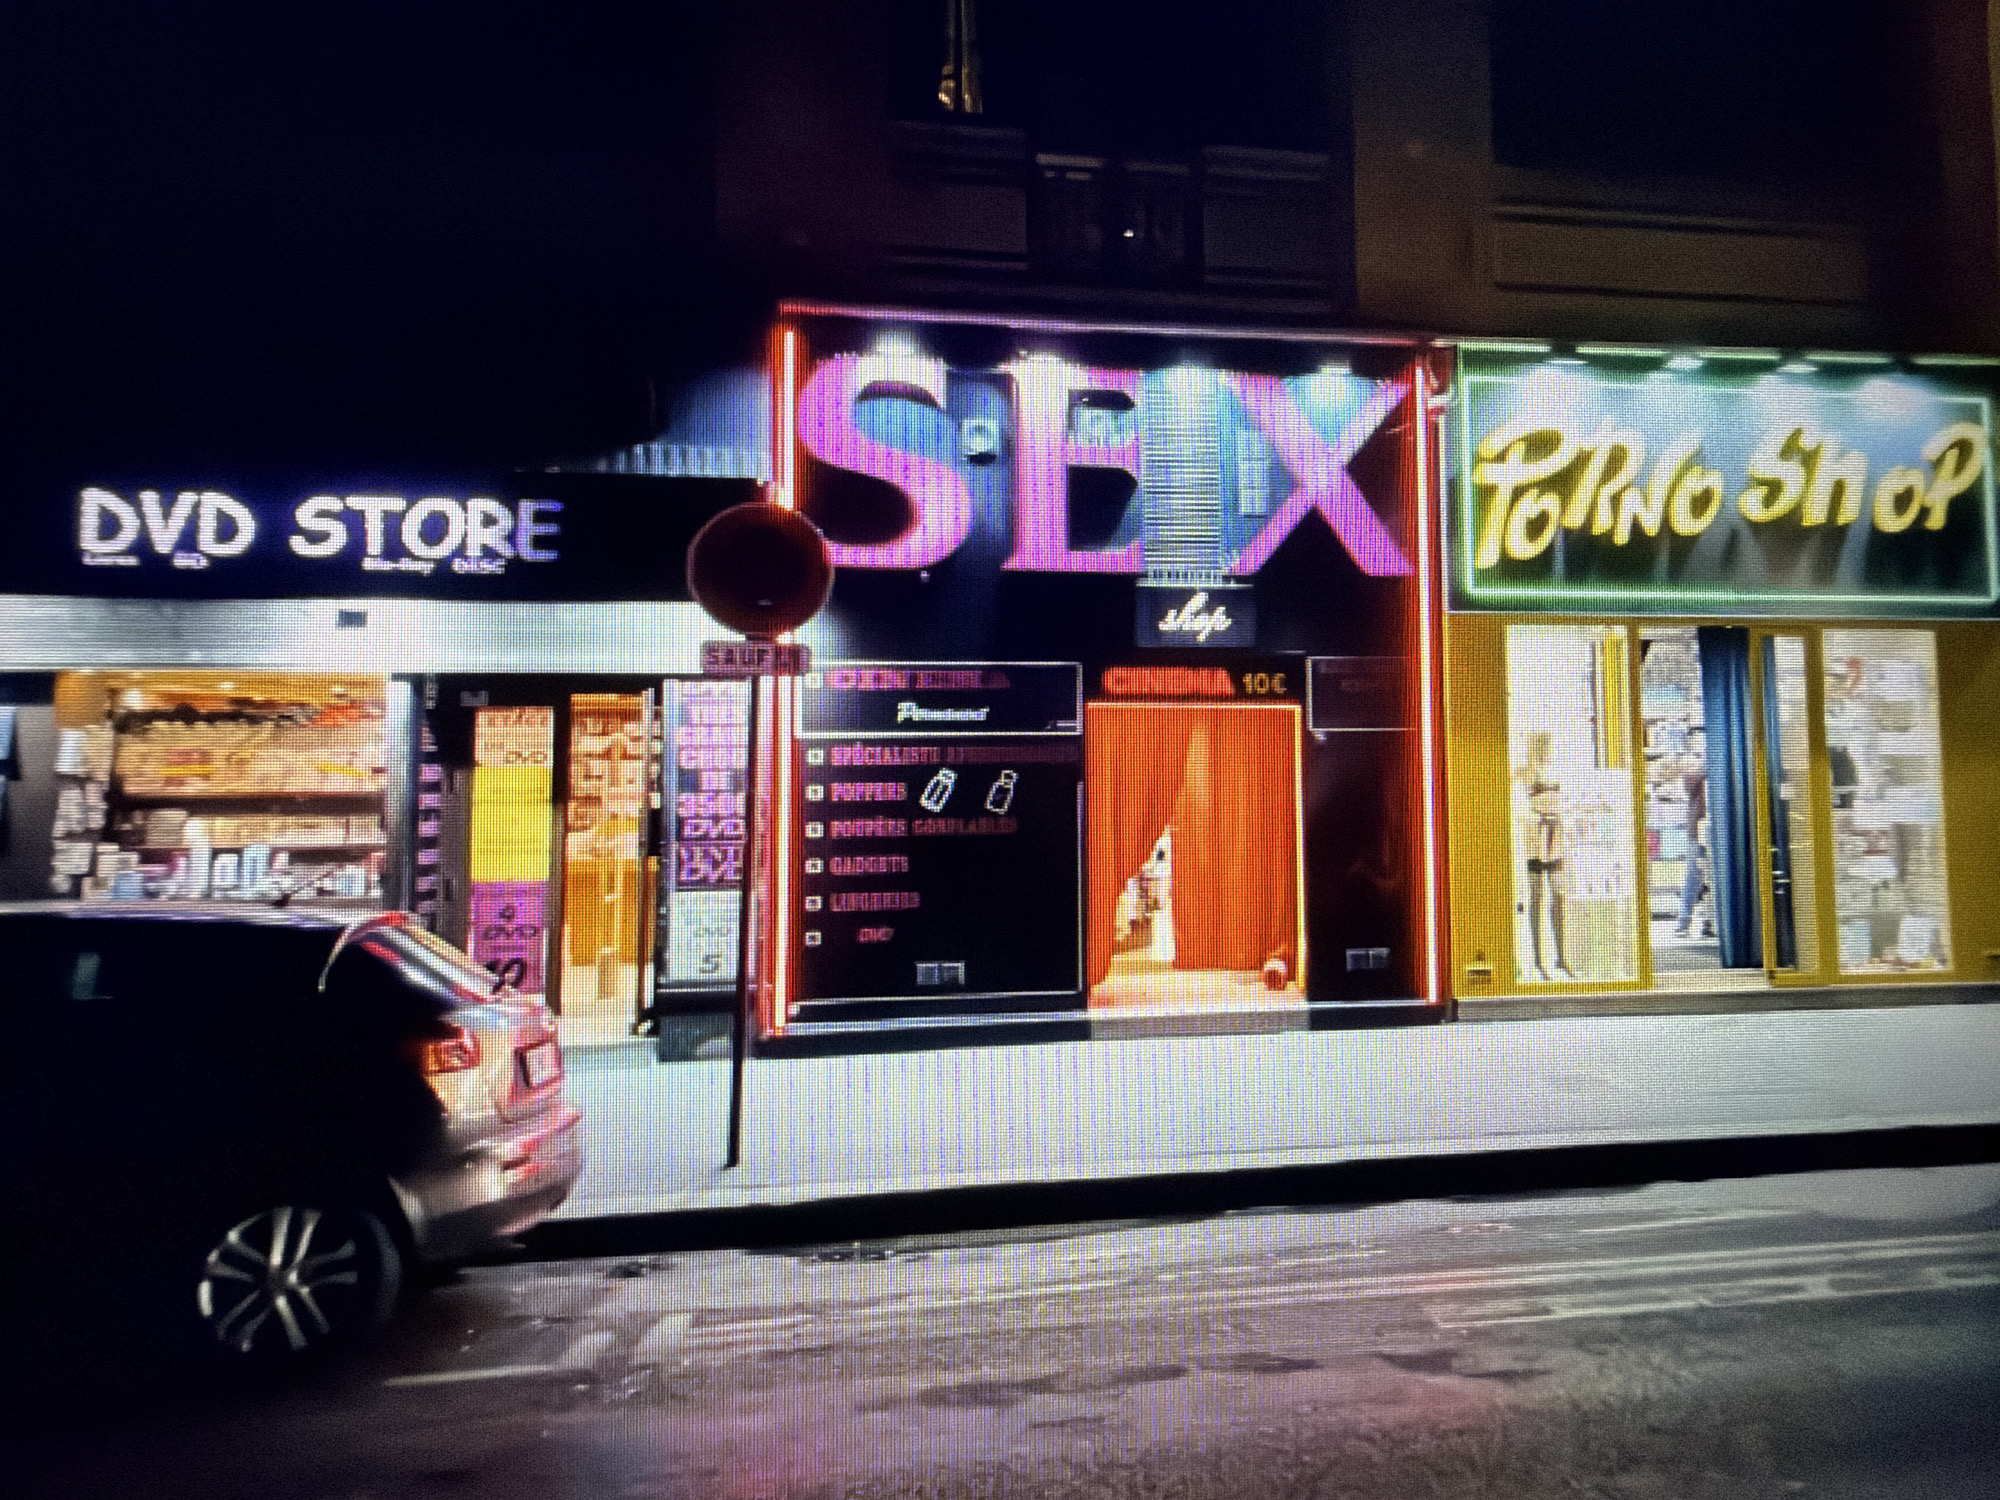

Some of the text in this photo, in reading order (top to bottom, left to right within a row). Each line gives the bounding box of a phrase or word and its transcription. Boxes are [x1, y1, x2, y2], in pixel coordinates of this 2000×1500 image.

[797, 352, 1414, 578] SEX
[80, 487, 565, 561] DVD STORE
[1158, 591, 1232, 643] shop
[704, 646, 768, 666] SAUF
[1242, 672, 1287, 694] 10€
[830, 782, 907, 801] POPPERS
[683, 818, 746, 838] DVD
